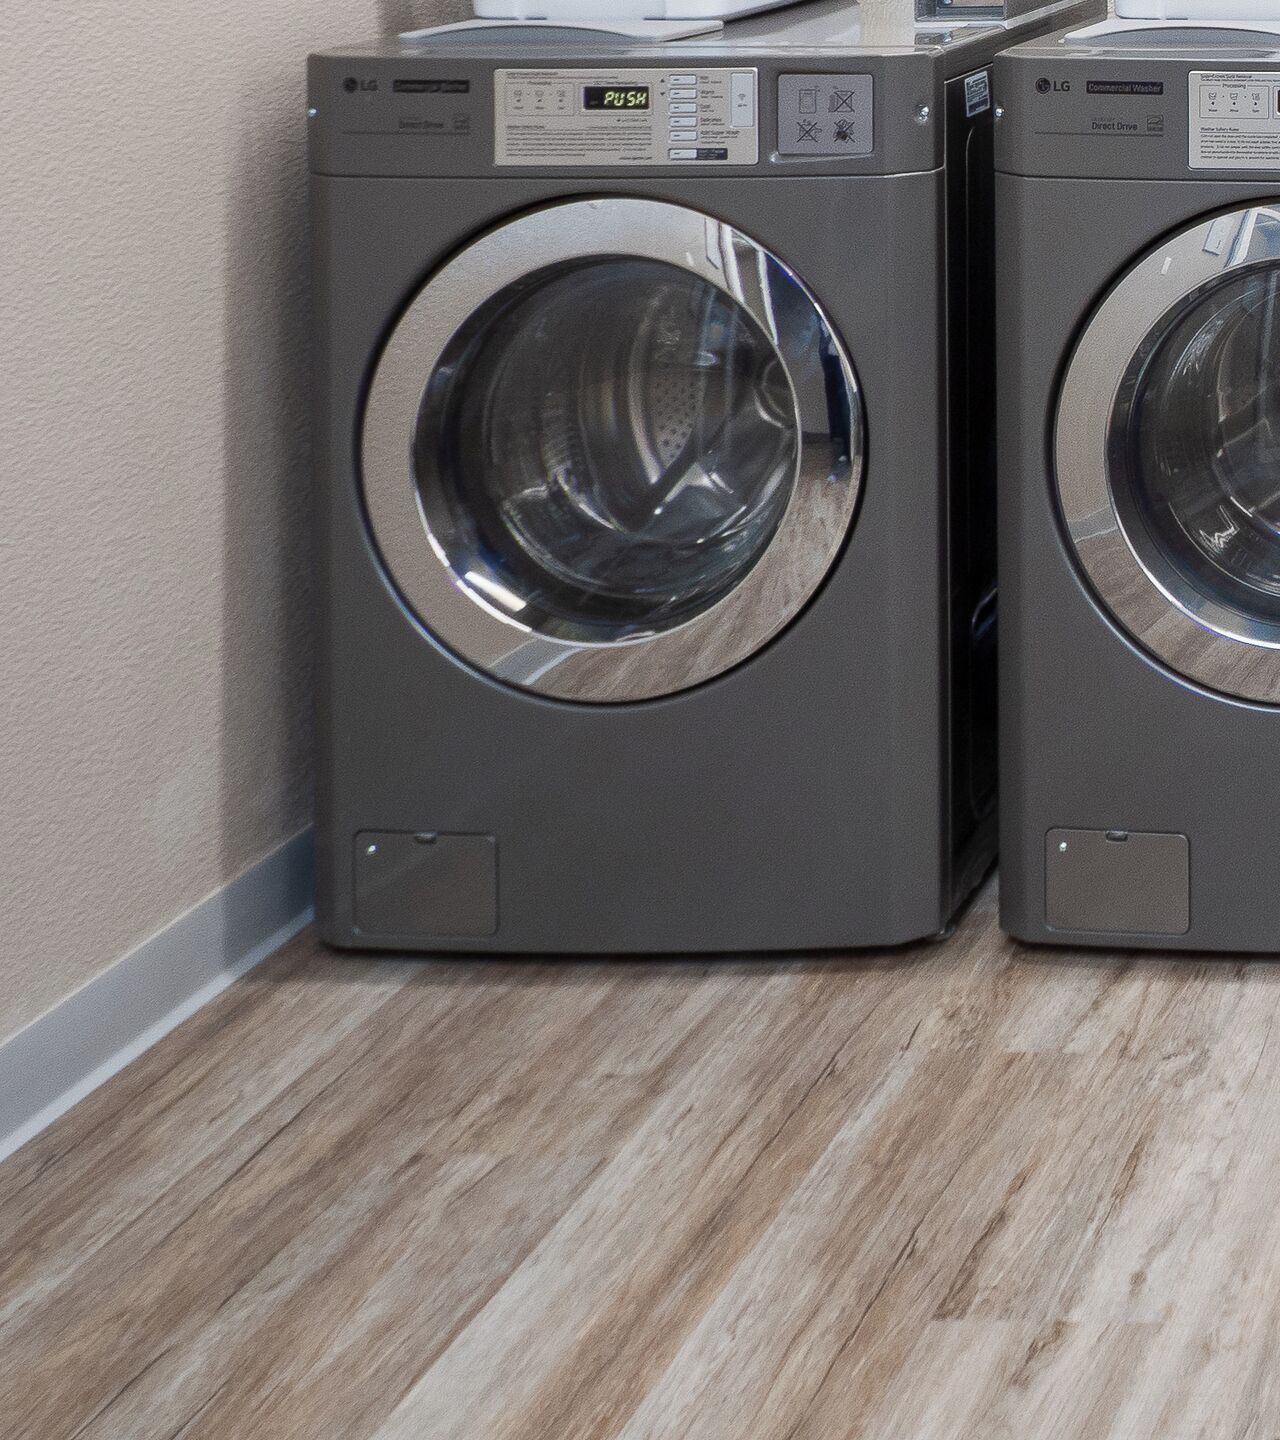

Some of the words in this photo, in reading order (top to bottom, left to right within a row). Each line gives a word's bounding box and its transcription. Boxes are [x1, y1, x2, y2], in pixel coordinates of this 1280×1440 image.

[1132, 84, 1161, 93] Washer
[604, 91, 647, 106] PUSH
[1092, 122, 1115, 130] Direct
[1117, 122, 1138, 131] Drive
